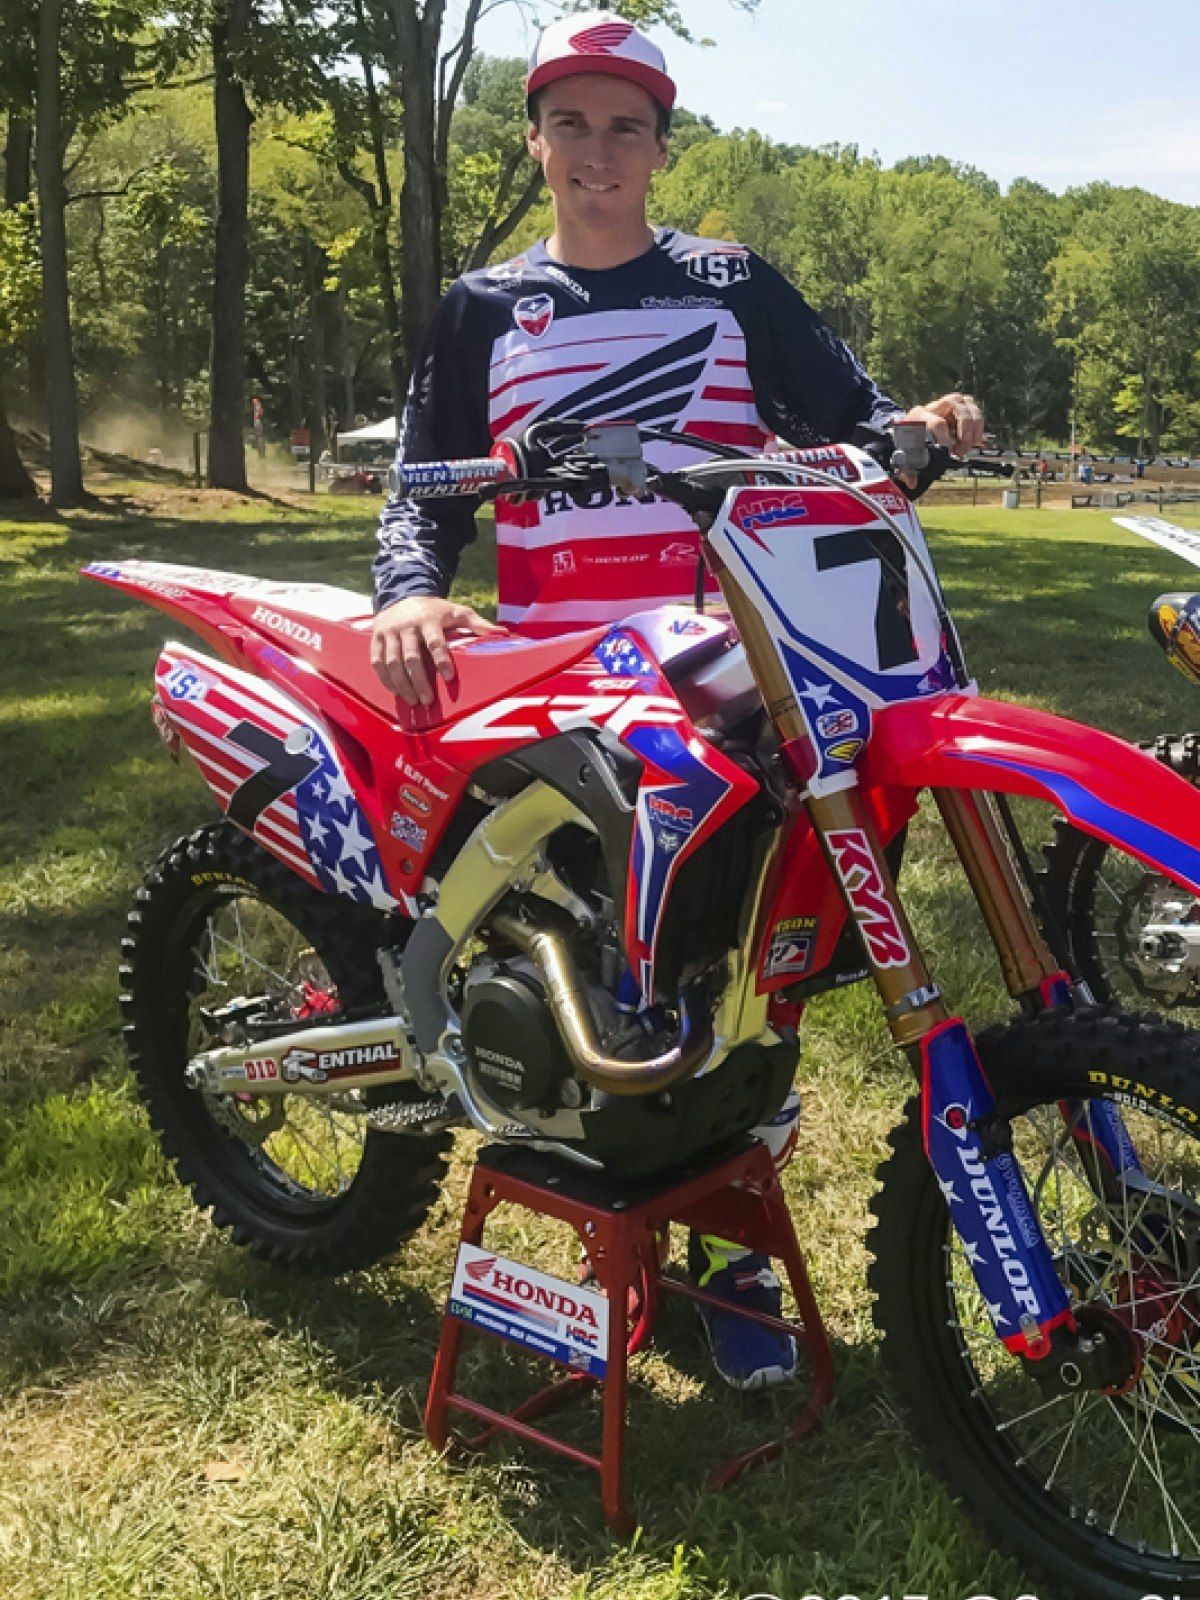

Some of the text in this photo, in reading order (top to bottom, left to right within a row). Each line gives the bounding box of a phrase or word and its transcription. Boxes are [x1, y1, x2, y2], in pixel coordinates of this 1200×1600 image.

[252, 605, 323, 652] HONDA
[812, 528, 919, 672] 7
[226, 719, 320, 832] 7
[825, 829, 909, 969] KYB
[476, 1046, 526, 1073] HONDA
[957, 1146, 1042, 1316] DUNLOP
[492, 1269, 599, 1329] HONDA
